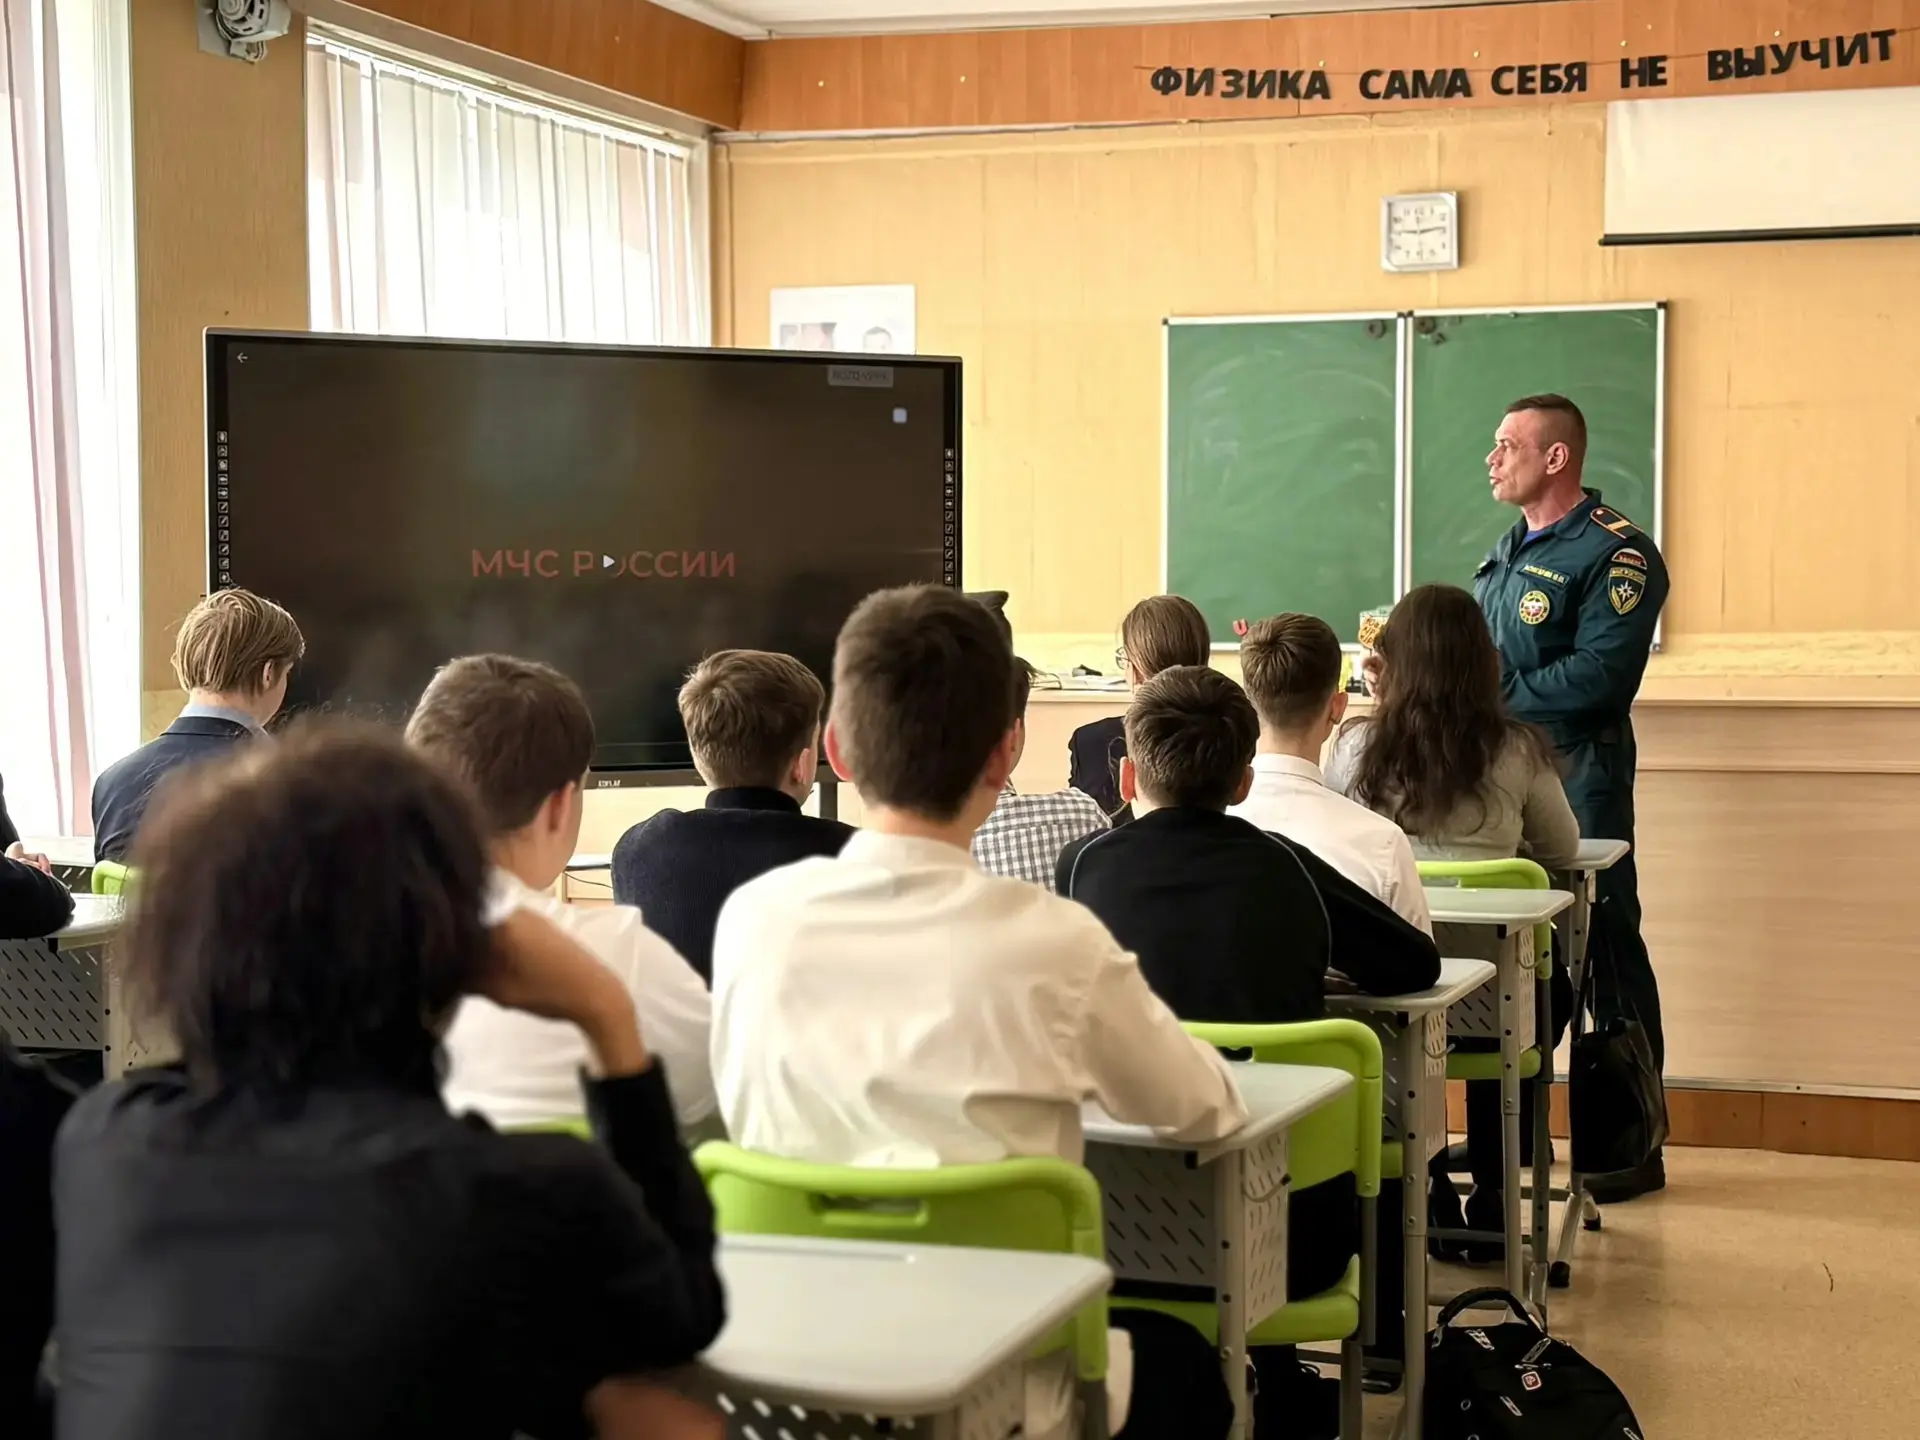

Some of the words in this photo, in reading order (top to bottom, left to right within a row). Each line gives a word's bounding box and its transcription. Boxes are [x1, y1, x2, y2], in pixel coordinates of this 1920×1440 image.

[1151, 66, 1331, 100] ФИЗИКА
[1359, 68, 1473, 100] САМА
[1491, 61, 1588, 96] СЕБЯ
[1620, 55, 1668, 89] НЕ
[1707, 28, 1897, 82] ВЫУЧИТ
[472, 549, 560, 578] МЧС
